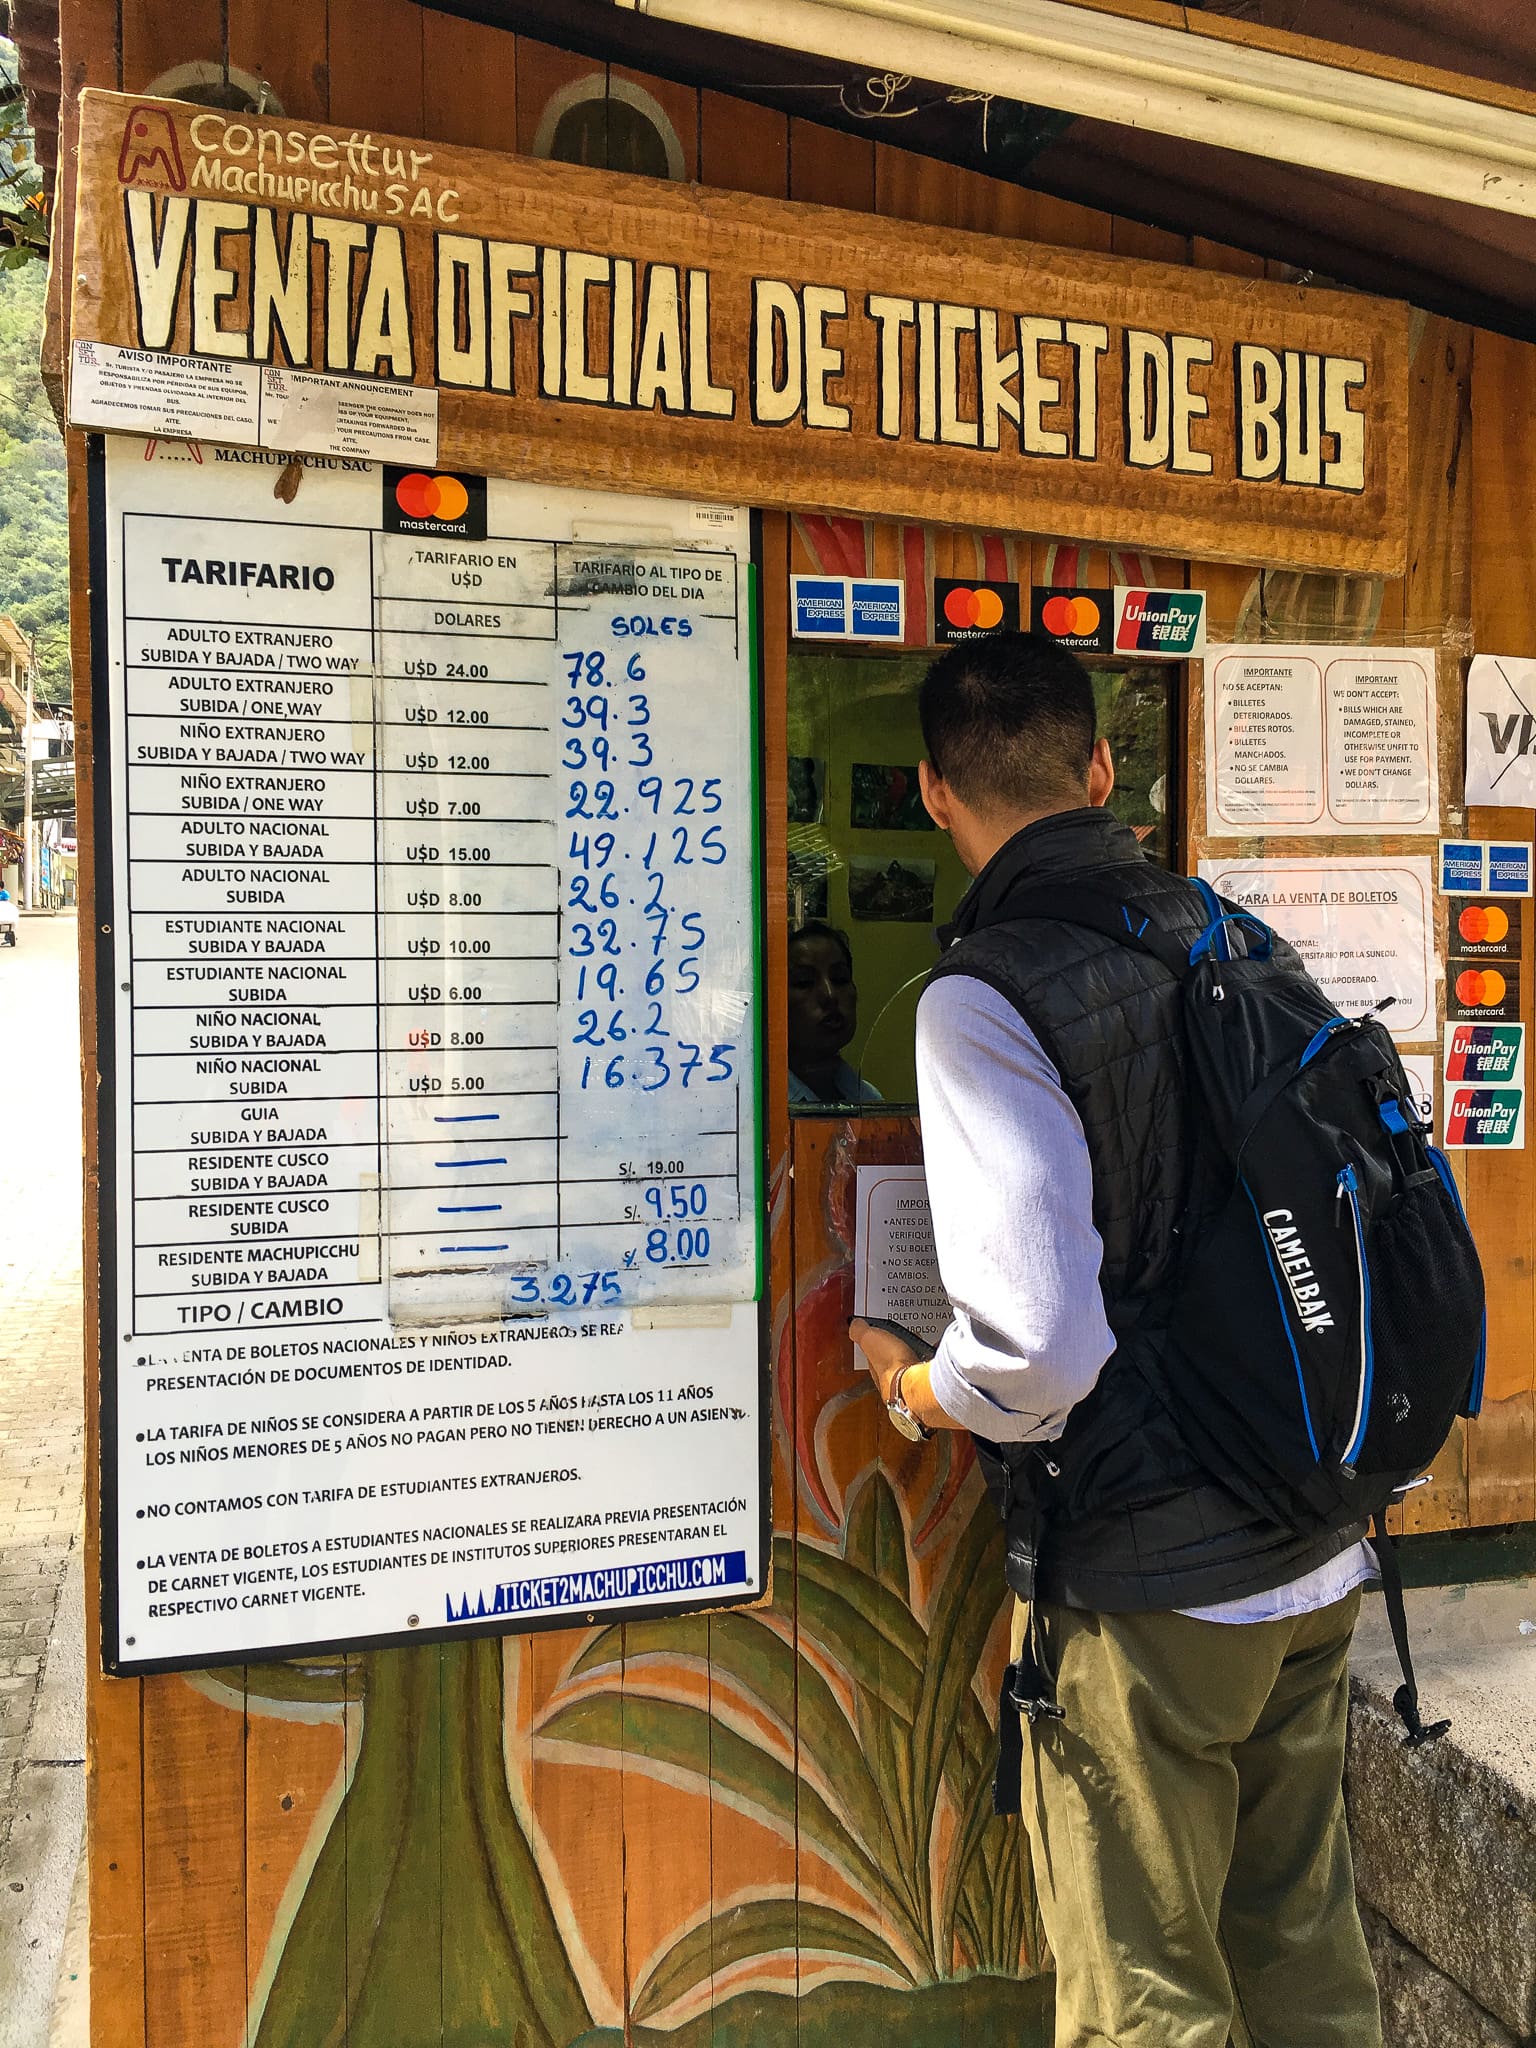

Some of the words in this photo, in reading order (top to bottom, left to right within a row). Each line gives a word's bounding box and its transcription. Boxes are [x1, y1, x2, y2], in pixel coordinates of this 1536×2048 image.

[190, 114, 433, 181] Consettur
[191, 155, 379, 215] Machupicchu
[385, 184, 459, 223] SAC
[124, 188, 415, 378] VENTA
[435, 230, 735, 420] OFICIAL
[750, 276, 853, 431] DE
[866, 293, 1108, 461] TICKET
[1122, 327, 1215, 476] DE
[1234, 342, 1367, 495] BUS
[118, 350, 153, 363] AVISO
[156, 355, 233, 374] IMPORTANTE
[342, 382, 414, 398] ANNOUNCEMENT
[329, 444, 341, 452] THE
[341, 446, 371, 456] COMPANY
[342, 459, 373, 472] SAC
[415, 551, 494, 568] TARIFARIO
[497, 556, 517, 569] EN
[161, 557, 335, 592] TARIFARIO
[573, 560, 646, 578] TARIFARIO
[649, 565, 667, 578] AL
[671, 567, 697, 580] TIPO
[700, 569, 723, 582] DE
[592, 582, 649, 597] CAMBIO
[652, 585, 677, 598] DEL
[681, 586, 705, 600] DIA
[797, 598, 843, 609] AMERICAN
[852, 600, 898, 611] AMERICAN
[434, 612, 501, 628] DOLARES
[807, 609, 845, 620] EXPRESS
[862, 611, 900, 622] EXPRESS
[1125, 605, 1197, 630] UnionPay
[611, 615, 693, 638] SOLES
[1152, 624, 1190, 642] 银联
[167, 628, 230, 644] ADULTO
[235, 631, 333, 648] EXTRANJERO
[141, 648, 198, 665] SUBIDA
[203, 651, 212, 664] Y
[216, 652, 275, 668] BAJADA
[287, 655, 322, 669] TWO
[326, 657, 359, 671] WAY
[446, 664, 489, 678] 24.00
[1244, 668, 1293, 677] IMPORTANTE
[1223, 683, 1234, 691] NO
[1246, 683, 1283, 691] ACEPTAN:
[1355, 676, 1398, 684] IMPORTANT
[1371, 690, 1399, 698] ACCEPT:
[447, 710, 489, 724] 12.00
[1343, 719, 1383, 728] DAMAGED,
[1384, 719, 1416, 727] STAINED,
[1234, 725, 1266, 733] BILLETES
[1267, 725, 1294, 733] ROTOS.
[1478, 712, 1536, 755] VI
[1234, 751, 1286, 759] MANCHADOS.
[181, 773, 222, 790] NIÑO
[226, 775, 326, 792] EXTRANJERO
[1345, 781, 1379, 789] DOLLARS.
[181, 796, 240, 810] SUBIDA
[252, 797, 284, 811] ONE
[289, 799, 324, 812] WAY
[448, 802, 481, 815] 7.00
[181, 821, 245, 835] ADULTO
[249, 823, 329, 836] NACIONAL
[186, 844, 245, 857] SUBIDA
[249, 845, 259, 857] Y
[263, 844, 324, 858] BAJADA
[449, 848, 491, 861] 15.00
[1443, 860, 1481, 868] AMERICAN
[1497, 871, 1529, 879] EXPRESS
[449, 893, 482, 907] 8.00
[1237, 894, 1269, 904] PARA
[1272, 894, 1286, 904] LA
[1289, 893, 1328, 904] VENTA
[1330, 892, 1345, 903] DE
[1348, 891, 1398, 903] BOLETOS
[167, 967, 263, 981] ESTUDIANTE
[268, 966, 347, 980] NACIONAL
[229, 988, 287, 1002] SUBIDA
[1454, 1039, 1517, 1060] UnionPay
[196, 1058, 237, 1074] NIÑO
[241, 1059, 321, 1073] NACIONAL
[1477, 1056, 1510, 1071] 银联
[229, 1081, 288, 1095] SUBIDA
[450, 1077, 485, 1091] 5.00
[240, 1107, 279, 1121] GUIA
[1453, 1102, 1517, 1123] UnionPay
[1476, 1119, 1510, 1134] 银联
[188, 1154, 273, 1171] RESIDENTE
[277, 1152, 329, 1168] CUSCO
[646, 1160, 684, 1175] 19.00
[191, 1176, 250, 1192] SUBIDA
[253, 1176, 263, 1189] Y
[267, 1174, 328, 1189] BAJADA
[645, 1183, 707, 1219] 9.50
[889, 1231, 932, 1240] VERIFIQUE
[645, 1227, 710, 1263] 8.00
[158, 1249, 244, 1266] RESIDENTE
[247, 1243, 360, 1263] MACHUPICCHU
[887, 1271, 929, 1280] CAMBIOS.
[1263, 1208, 1335, 1333] CAMELBAK
[510, 1271, 622, 1305] 3.275
[177, 1304, 231, 1324] TIPO
[251, 1297, 344, 1320] CAMBIO
[146, 1368, 266, 1391] PRESENTACIÓN
[270, 1370, 290, 1383] DE
[294, 1362, 402, 1382] DOCUMENTOS
[406, 1360, 425, 1373] DE
[429, 1354, 512, 1372] IDENTIDAD.
[147, 1504, 170, 1518] NO
[174, 1495, 263, 1516] CONTAMOS
[266, 1492, 299, 1508] CON
[302, 1487, 354, 1504] TARIFA
[357, 1486, 377, 1499] DE
[380, 1477, 477, 1498] ESTUDIANTES
[480, 1468, 582, 1490] EXTRANJEROS.
[148, 1596, 237, 1618] RESPECTIVO
[241, 1590, 298, 1609] CARNET
[302, 1583, 365, 1602] VIGENTE.
